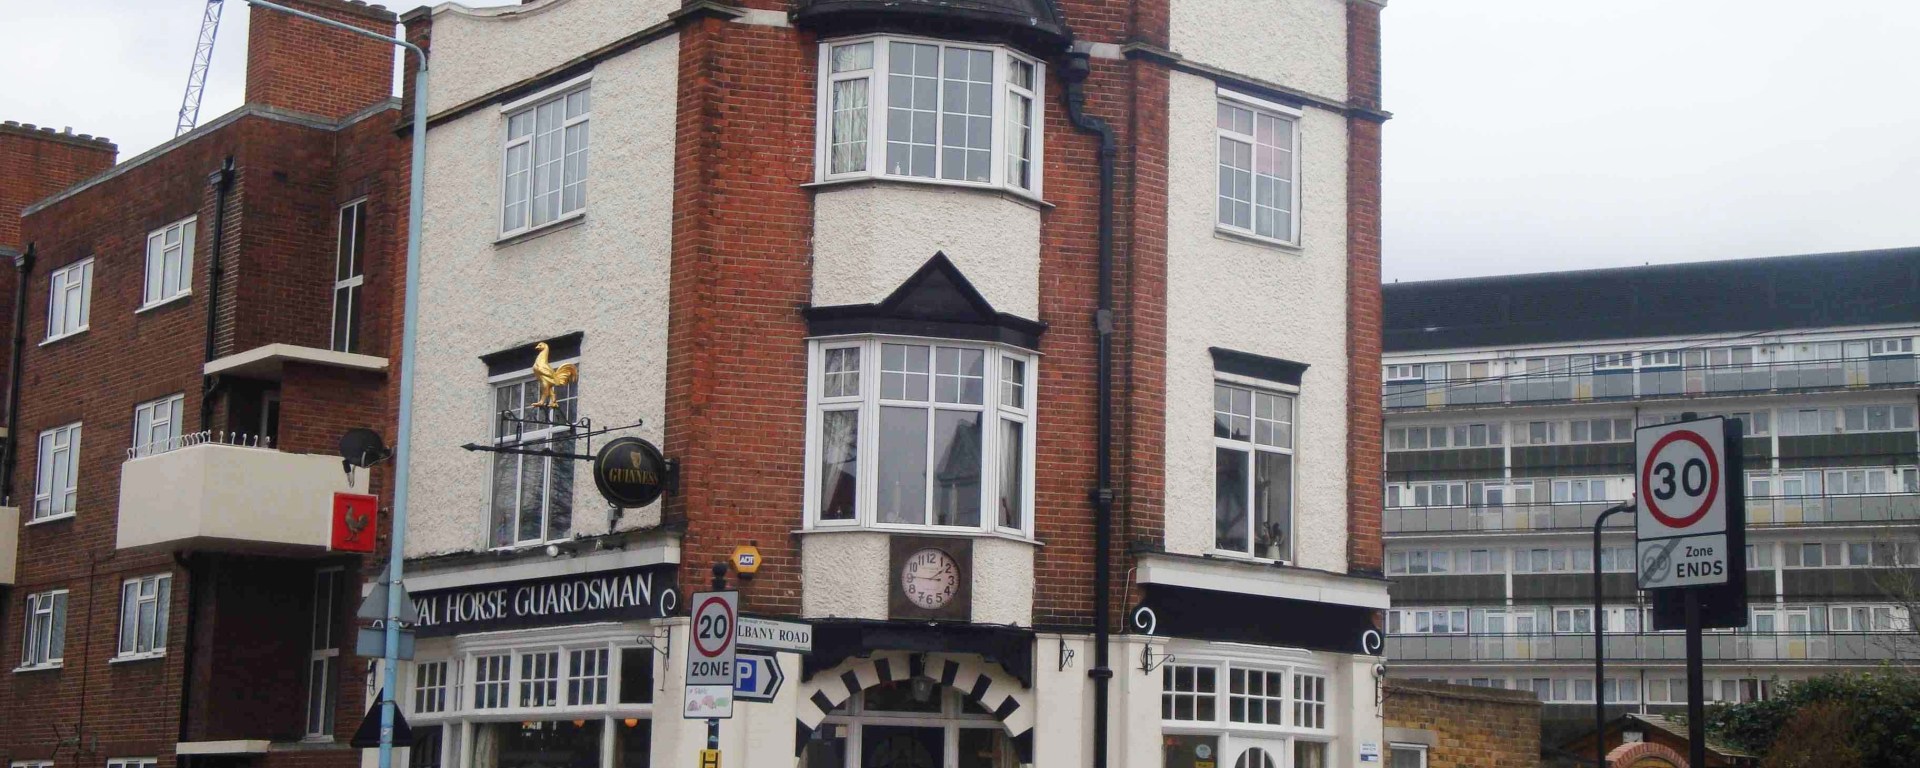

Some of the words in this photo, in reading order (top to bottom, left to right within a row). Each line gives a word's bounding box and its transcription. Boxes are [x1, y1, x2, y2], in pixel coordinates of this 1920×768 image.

[1653, 457, 1708, 501] 30
[1685, 545, 1713, 559] Zone
[739, 554, 754, 565] ADT
[918, 554, 925, 566] 11
[927, 553, 936, 564] 12
[909, 562, 917, 573] 10
[945, 563, 951, 574] 2
[1677, 560, 1723, 579] ENDS
[907, 573, 914, 583] 9
[948, 576, 954, 586] 3
[909, 584, 916, 594] 8
[944, 586, 950, 596] 4
[446, 589, 508, 622] HORSE
[514, 573, 654, 616] GUARDSMAN
[918, 592, 925, 602] 7
[926, 595, 933, 605] 6
[936, 593, 942, 603] 5
[699, 614, 728, 640] 20
[738, 625, 775, 640] LBANY
[779, 629, 809, 644] ROAD
[691, 661, 730, 677] ZONE
[738, 663, 753, 689] P
